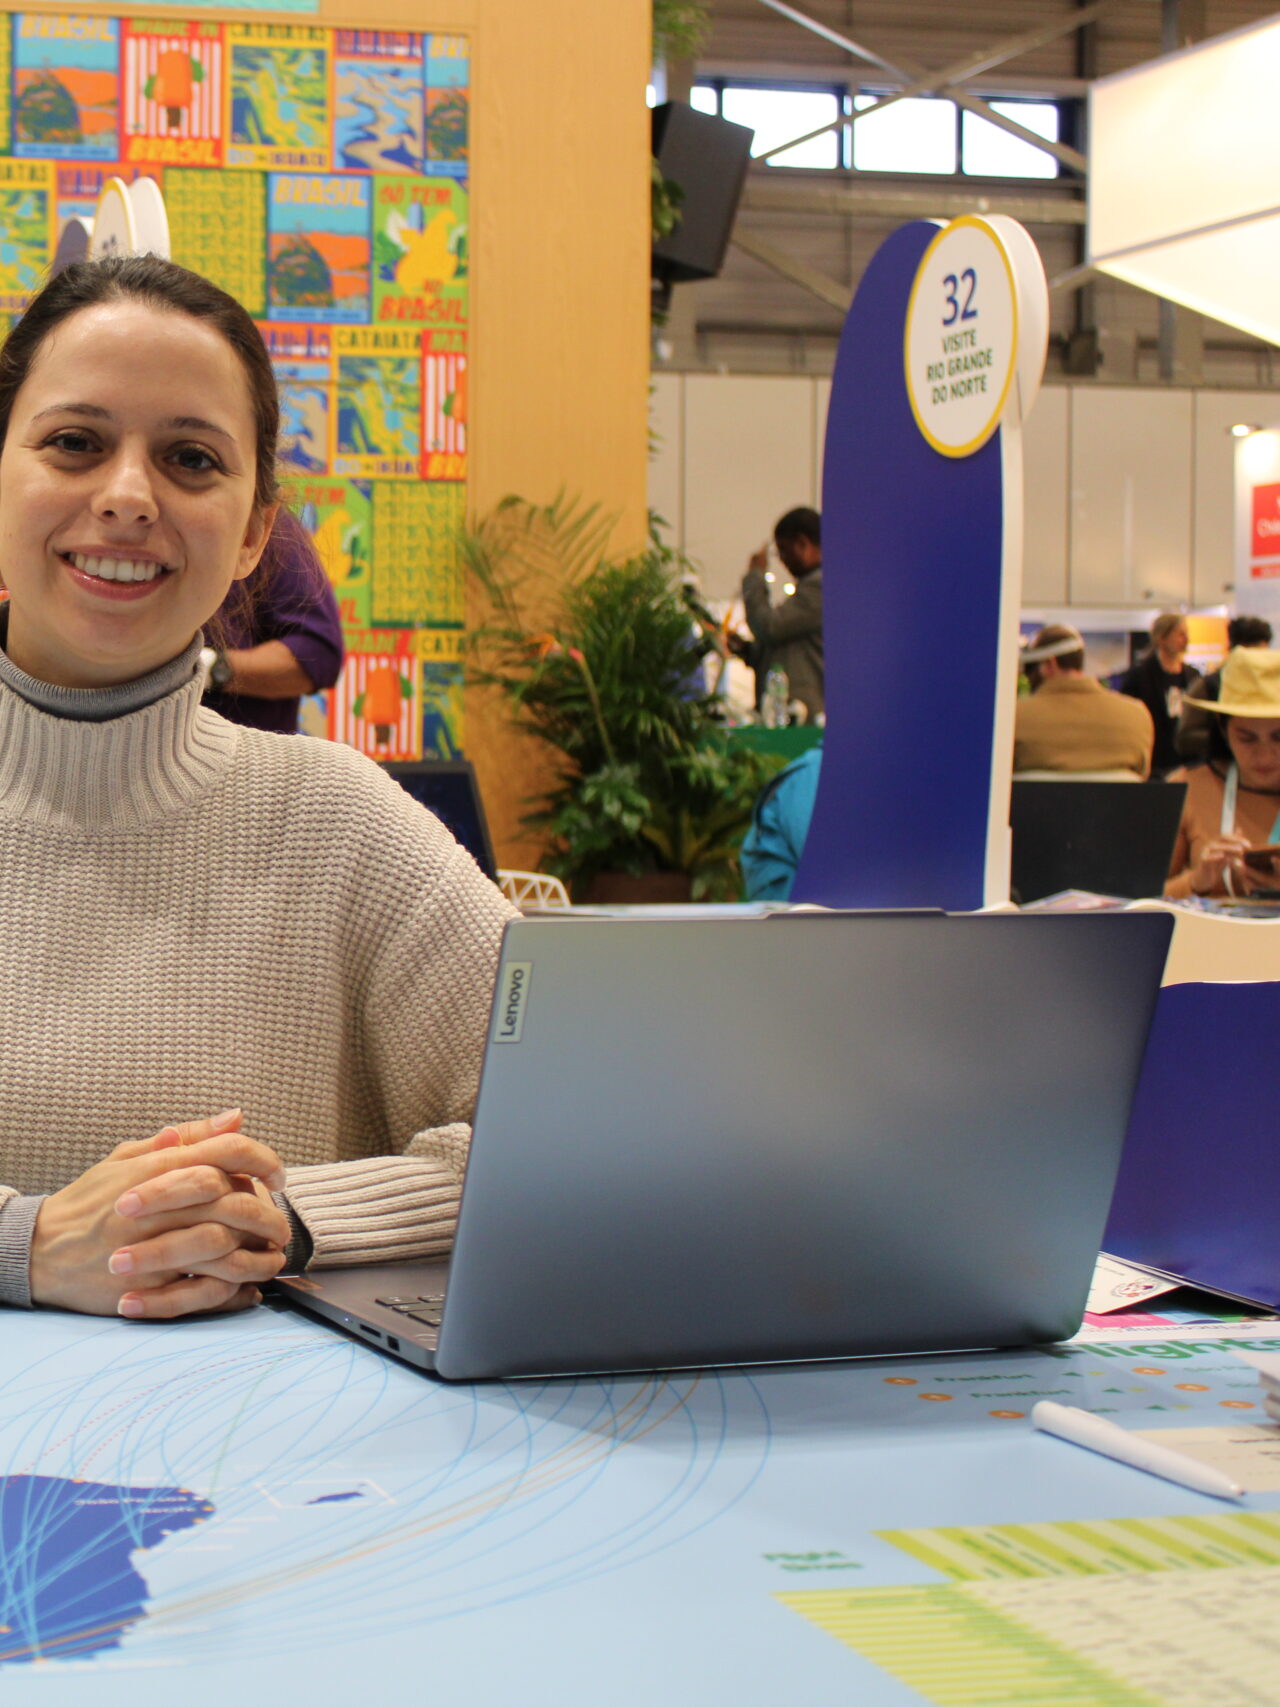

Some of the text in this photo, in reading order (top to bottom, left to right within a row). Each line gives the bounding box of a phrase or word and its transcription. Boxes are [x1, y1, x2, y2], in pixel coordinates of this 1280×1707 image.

[128, 138, 219, 164] BRASIL
[273, 177, 368, 208] BRASIL
[411, 186, 452, 206] TEM
[378, 297, 468, 323] BRASIL
[943, 269, 977, 325] 32
[943, 330, 976, 353] VISITE
[927, 349, 991, 381] RIO GRANDE
[932, 375, 988, 404] DO NORTE
[500, 968, 524, 1036] Lenovo
